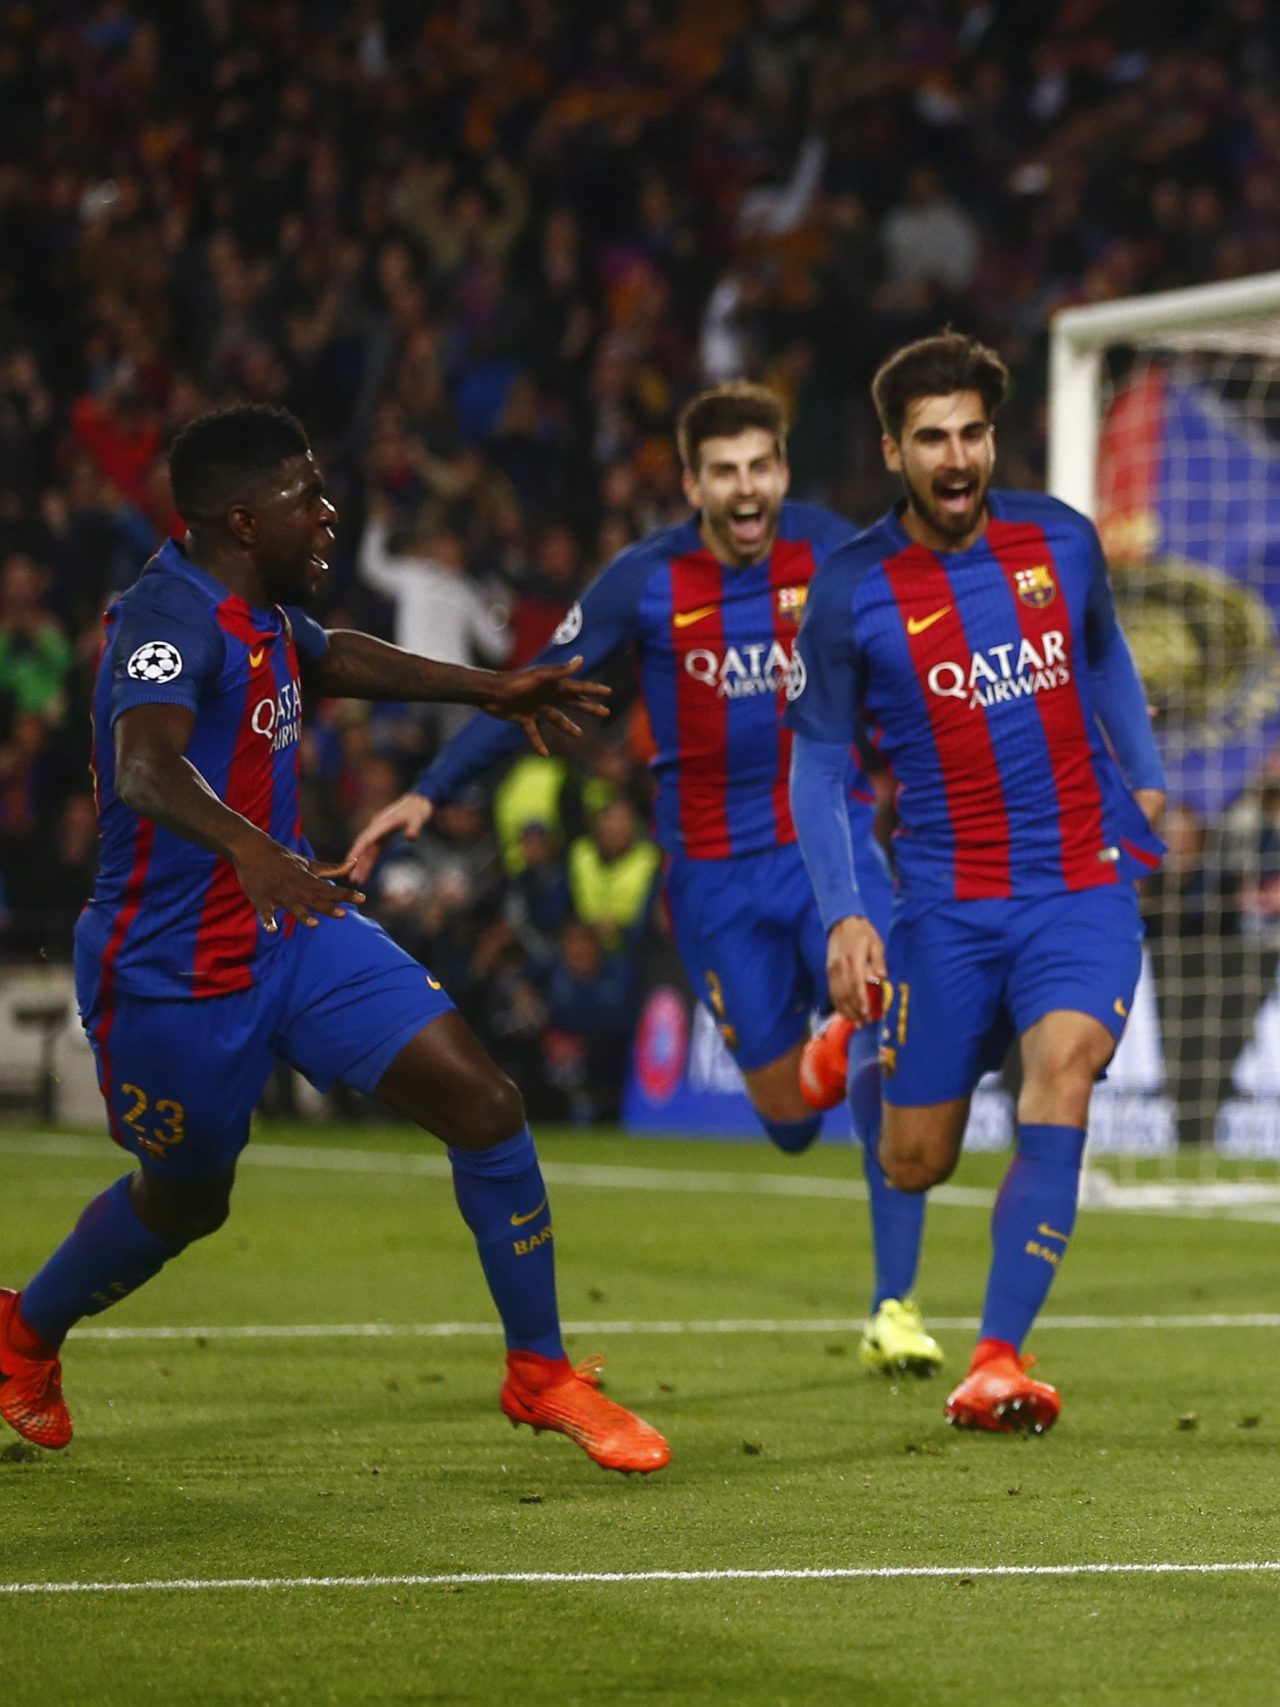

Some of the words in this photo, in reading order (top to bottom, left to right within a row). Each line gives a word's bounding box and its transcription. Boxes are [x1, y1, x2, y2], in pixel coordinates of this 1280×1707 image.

[927, 630, 1068, 699] QATAR
[968, 662, 1070, 711] AIRWAYS
[121, 1083, 185, 1145] 23
